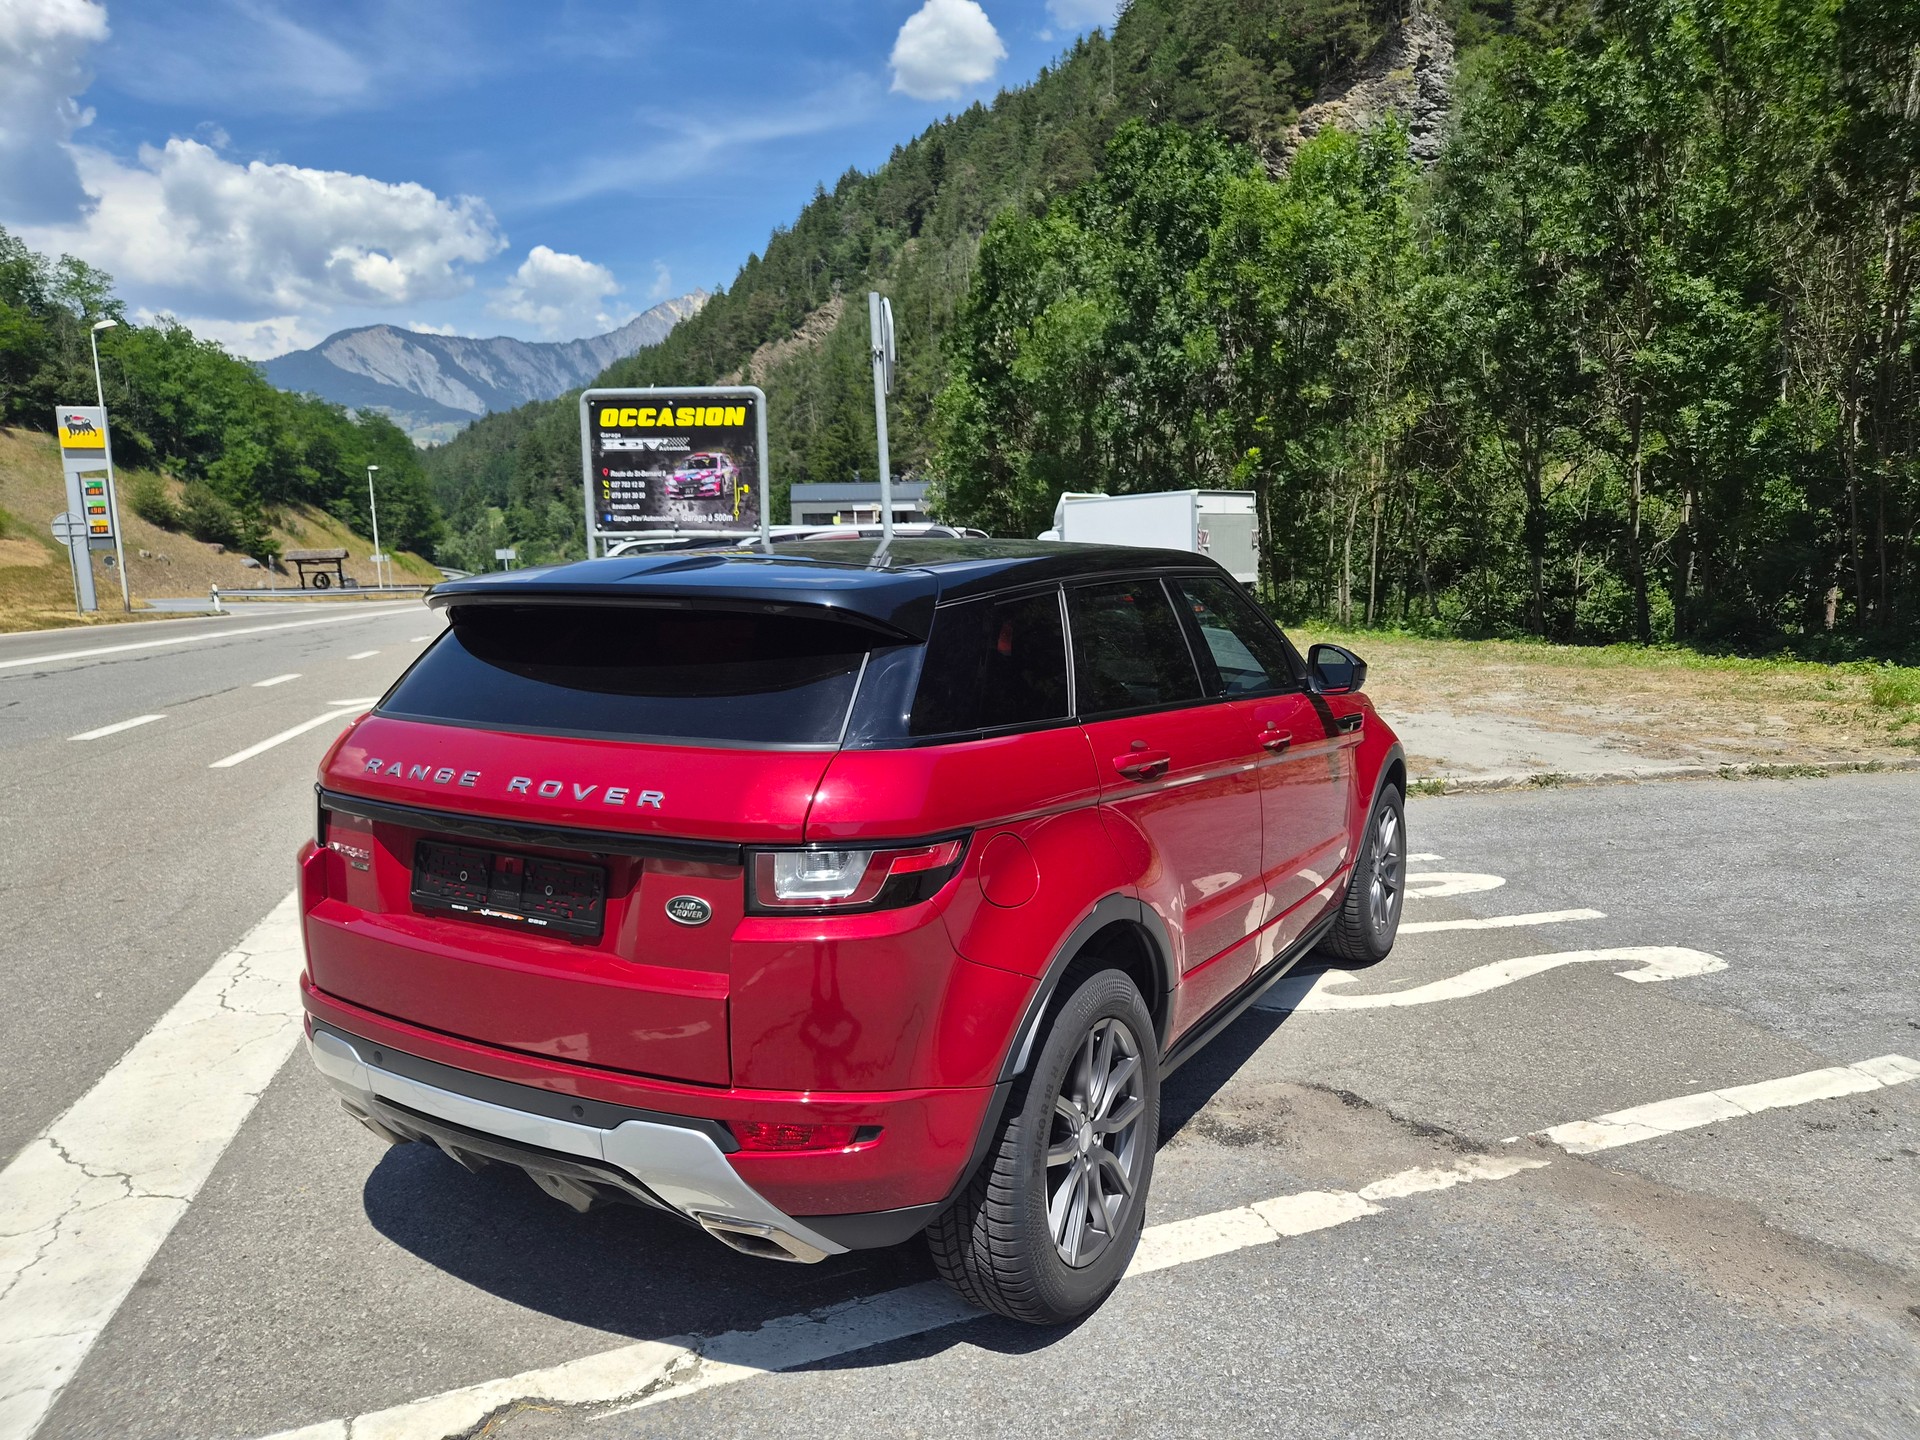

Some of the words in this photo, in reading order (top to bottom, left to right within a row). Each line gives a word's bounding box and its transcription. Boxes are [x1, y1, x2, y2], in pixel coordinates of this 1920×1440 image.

[600, 406, 746, 427] OCCASION
[613, 514, 632, 523] Garage
[681, 514, 707, 523] Garage
[363, 757, 482, 788] RANGE
[506, 775, 667, 809] ROVER
[674, 901, 697, 910] LAND
[676, 909, 703, 918] ROVER
